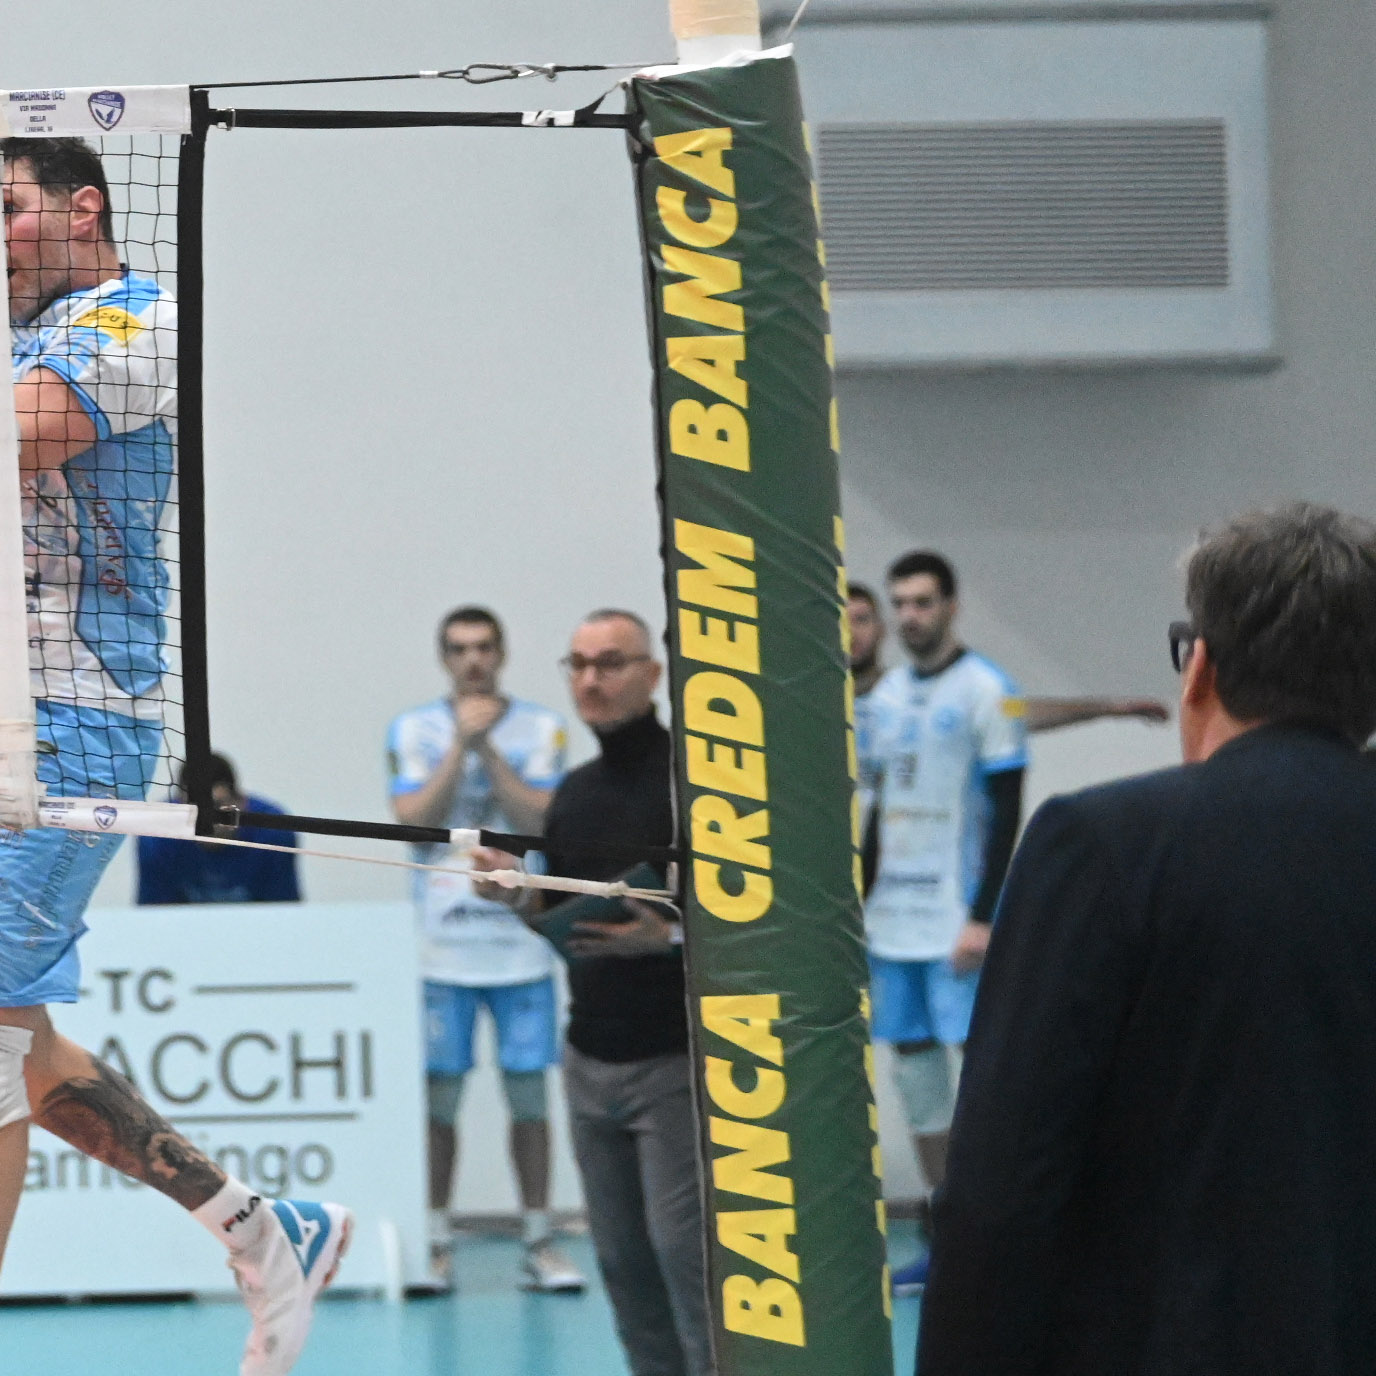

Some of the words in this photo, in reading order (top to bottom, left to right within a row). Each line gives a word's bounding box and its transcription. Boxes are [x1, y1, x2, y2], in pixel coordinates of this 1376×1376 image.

[654, 126, 752, 472] BANCA
[673, 517, 775, 923] CREDEM
[99, 1029, 374, 1106] ACCHI
[101, 969, 179, 1015] TC
[222, 1194, 261, 1232] FILA
[701, 993, 806, 1349] BANCA
